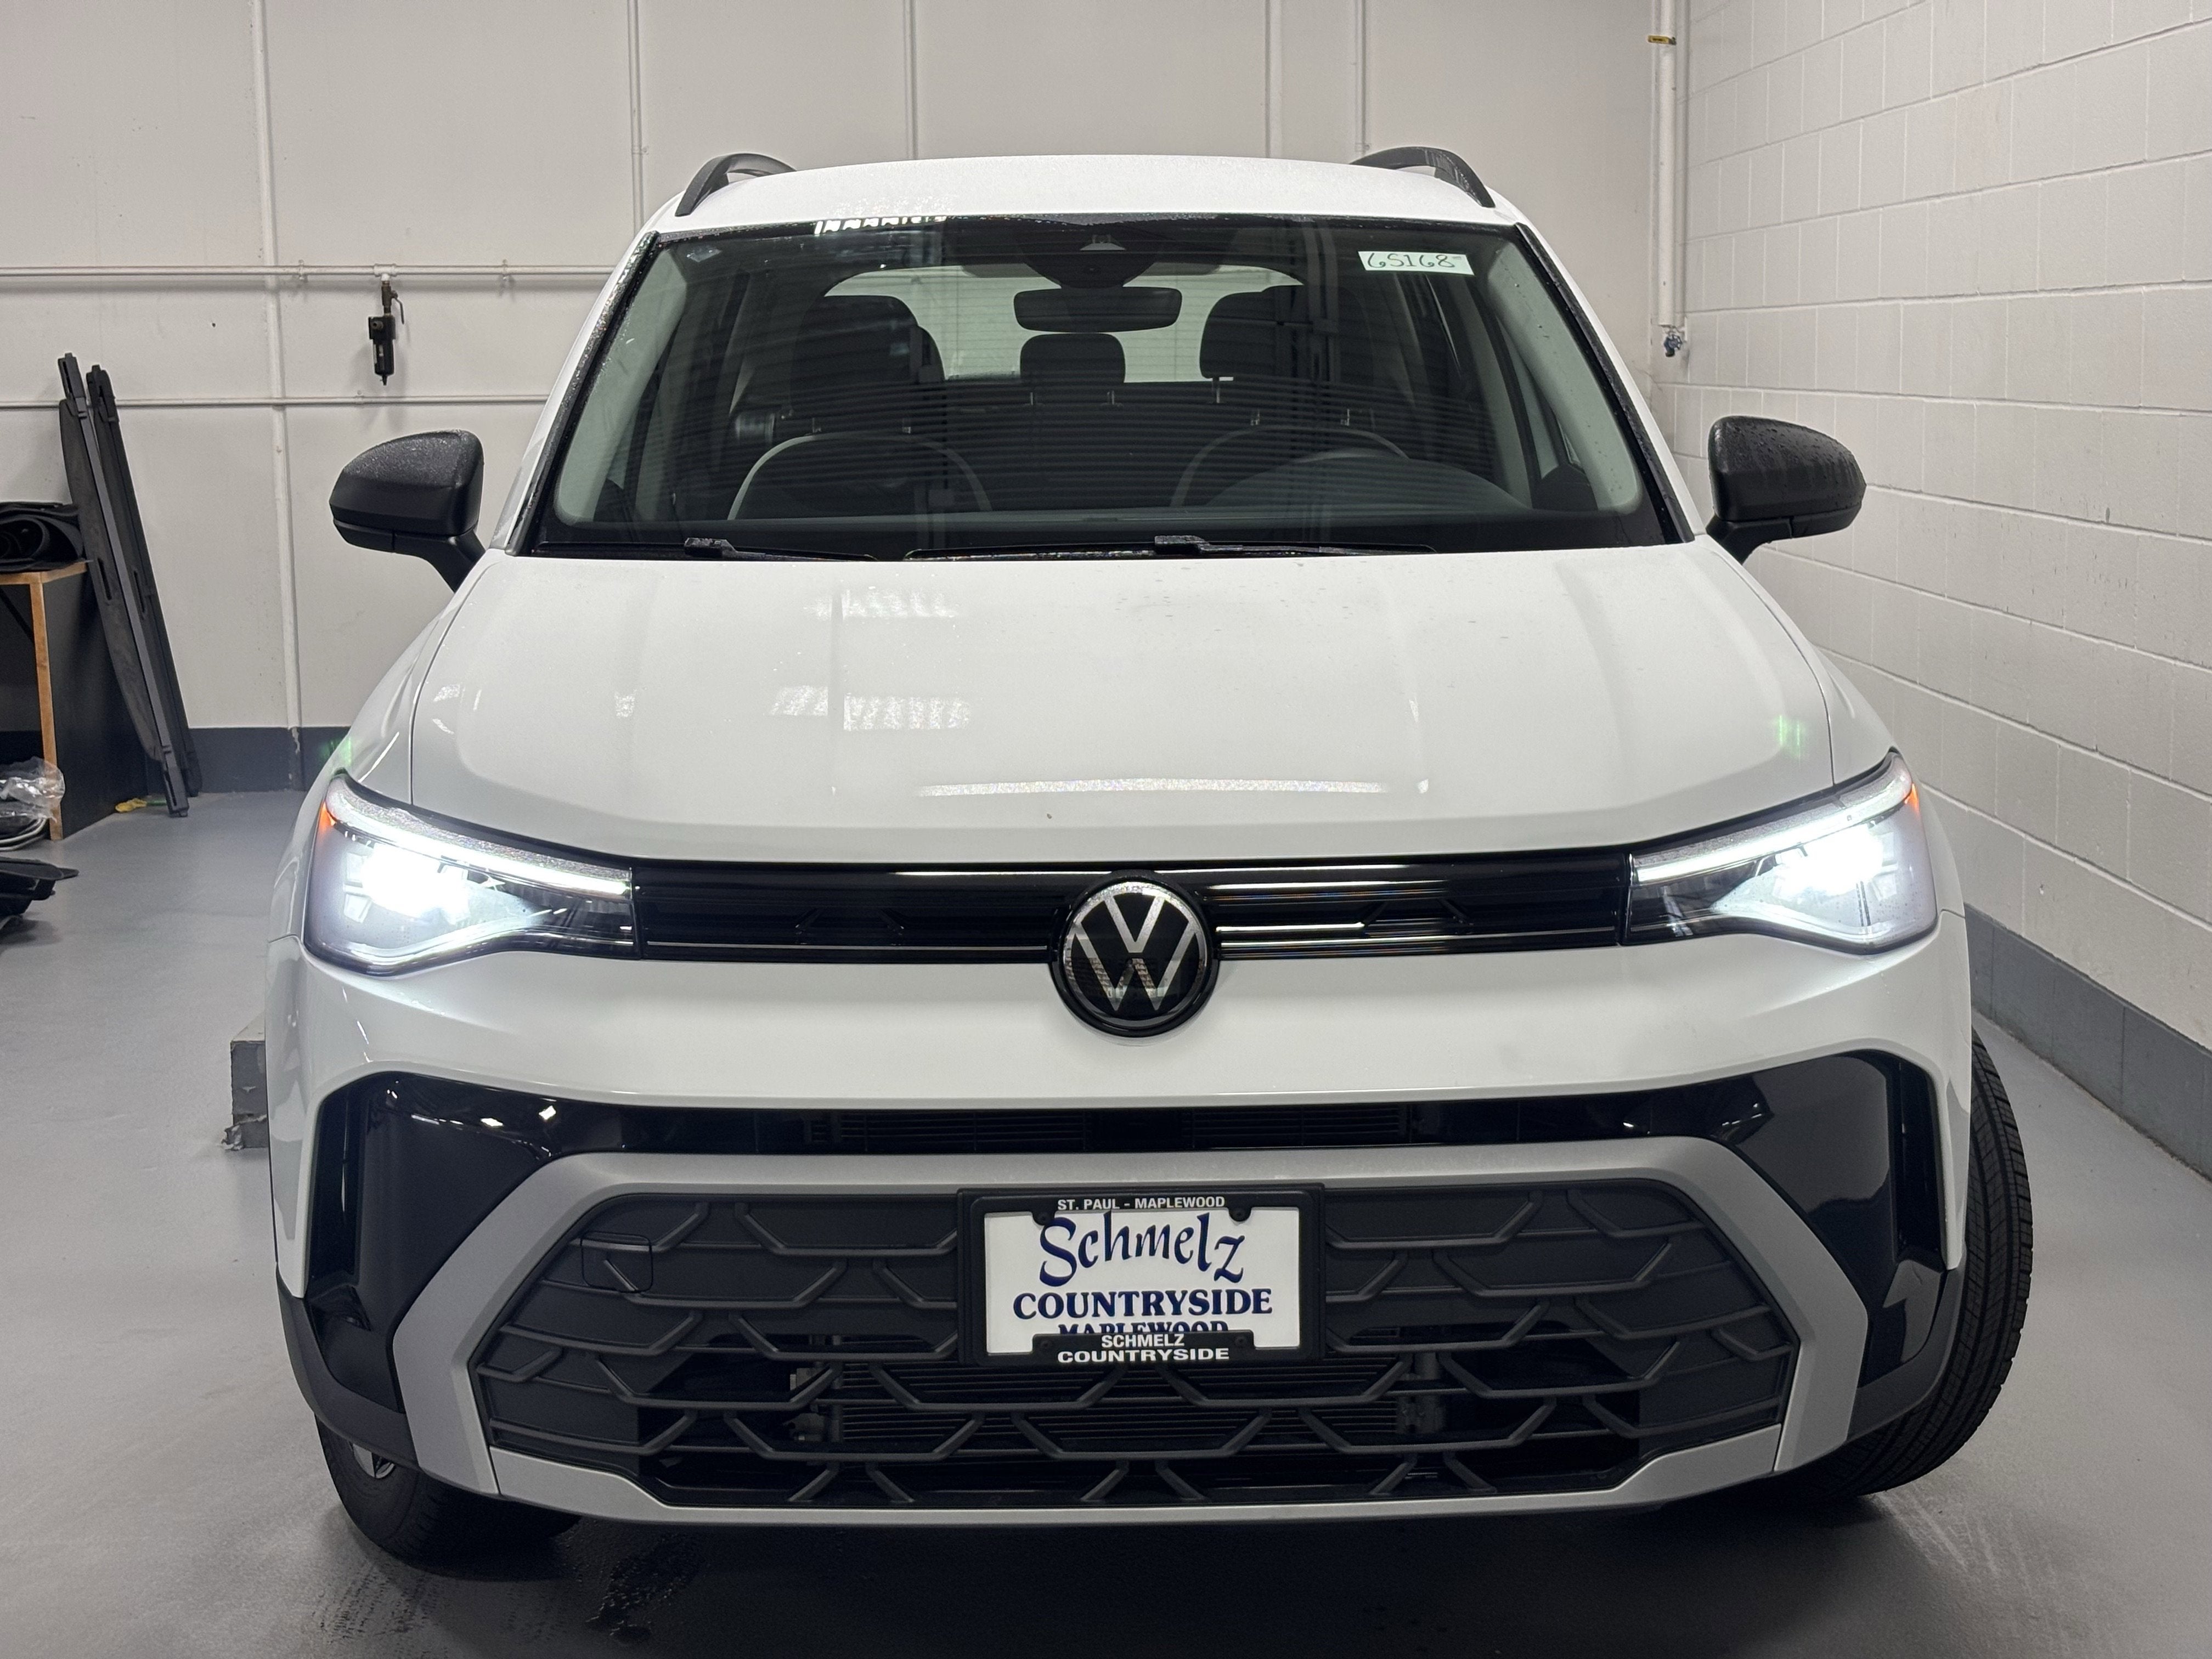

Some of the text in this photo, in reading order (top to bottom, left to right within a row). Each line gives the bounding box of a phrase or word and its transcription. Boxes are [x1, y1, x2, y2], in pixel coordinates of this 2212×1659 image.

[1367, 252, 1456, 268] 65168
[1069, 889, 1200, 1013] VW
[1057, 1199, 1079, 1210] ST.
[1084, 1198, 1120, 1210] PAUL
[1135, 1196, 1225, 1209] MAPLEWOOD
[1039, 1210, 1245, 1287] Schmelz
[1013, 1288, 1273, 1319] COUNTRYSIDE
[1101, 1334, 1185, 1348] SCHMELZ
[1057, 1348, 1229, 1363] COUNTRYSIDE
